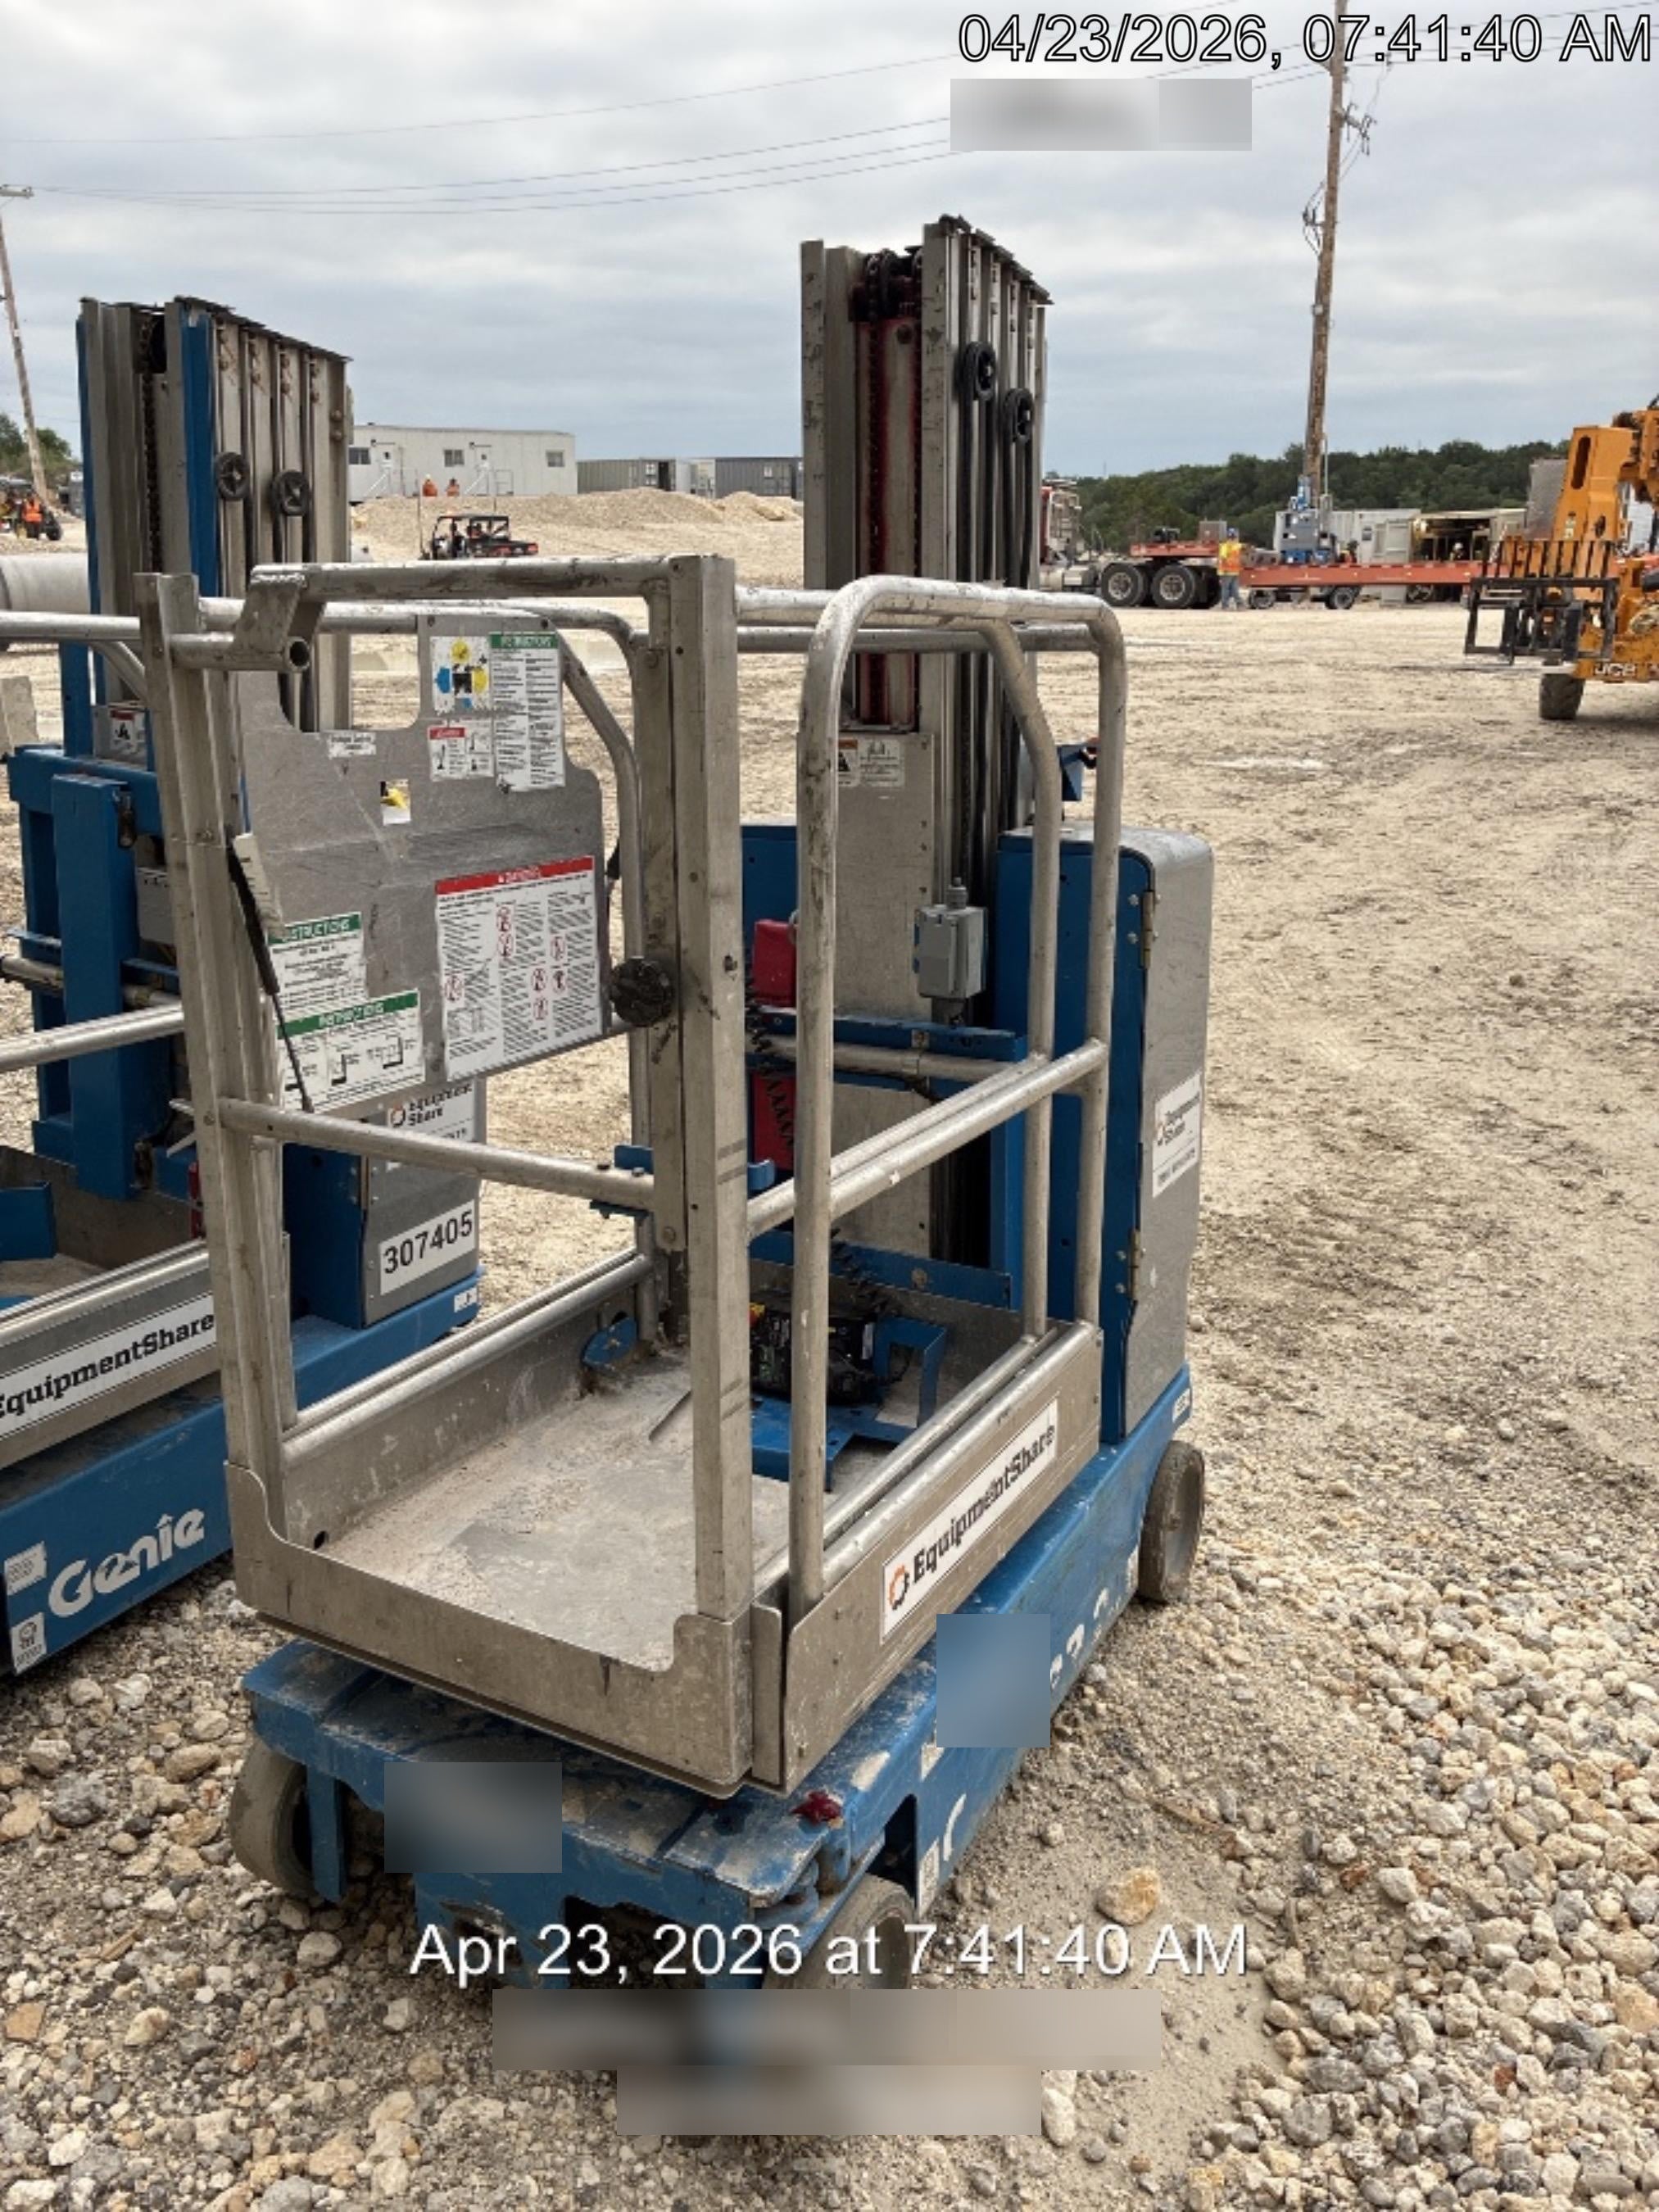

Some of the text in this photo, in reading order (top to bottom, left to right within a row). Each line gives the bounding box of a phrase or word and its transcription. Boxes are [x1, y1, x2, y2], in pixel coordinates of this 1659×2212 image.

[1594, 662, 1636, 677] JCB
[383, 1209, 473, 1275] 307405
[913, 1424, 1055, 1584] EquipmentShare
